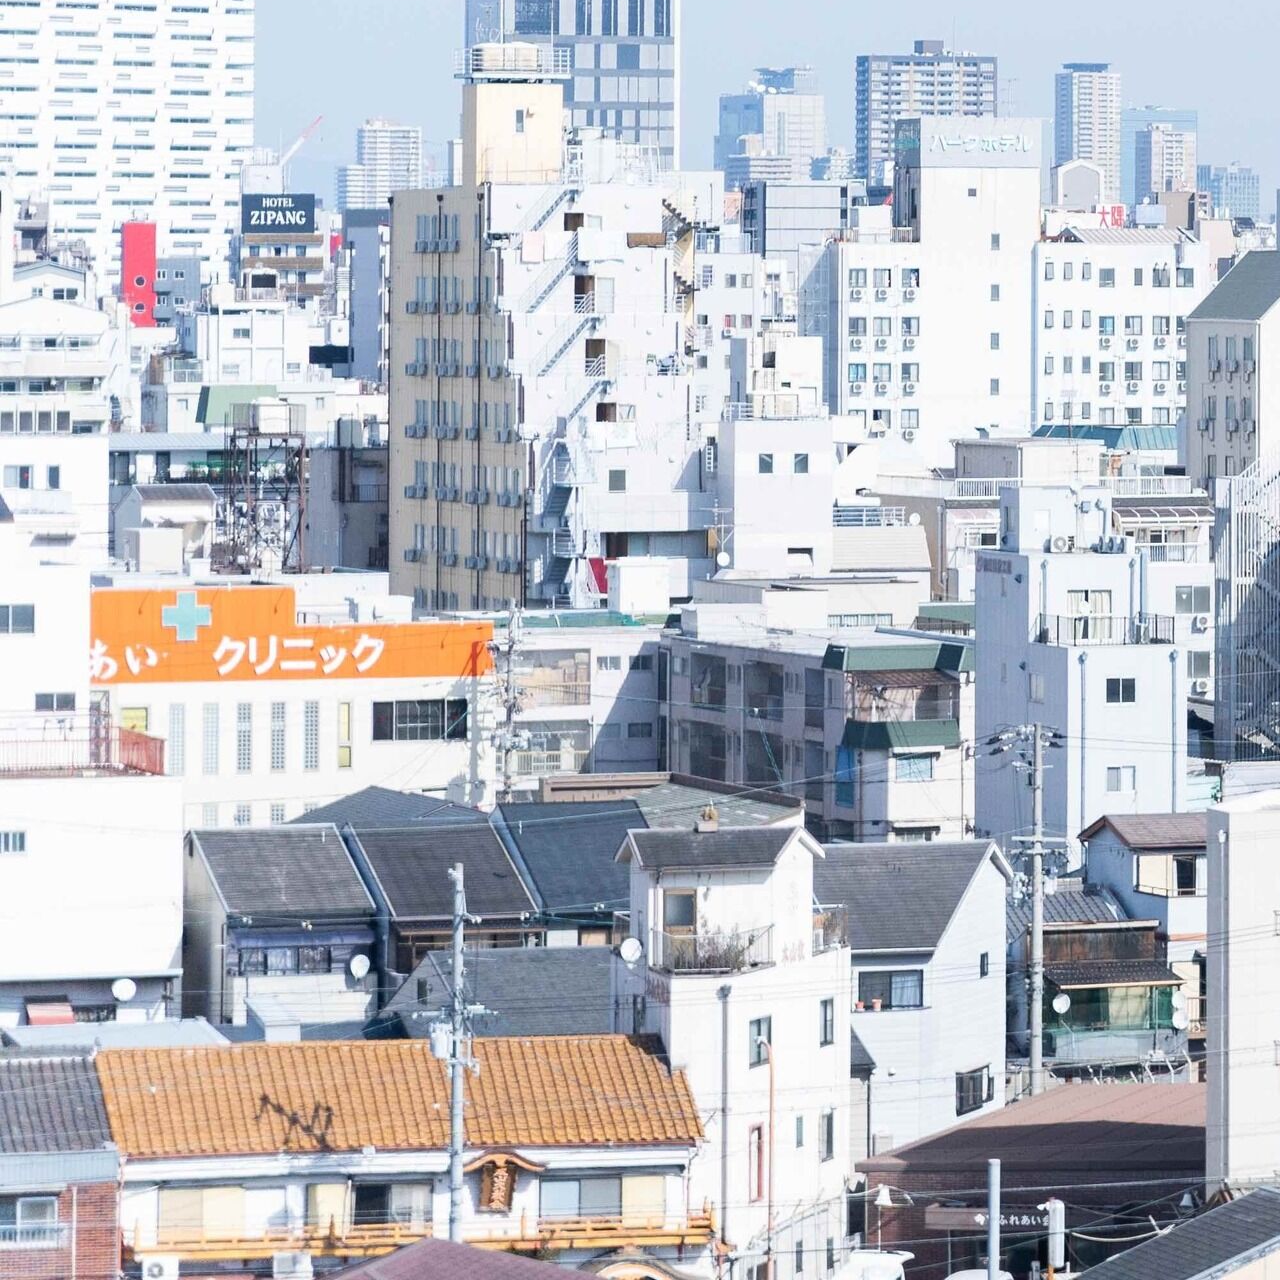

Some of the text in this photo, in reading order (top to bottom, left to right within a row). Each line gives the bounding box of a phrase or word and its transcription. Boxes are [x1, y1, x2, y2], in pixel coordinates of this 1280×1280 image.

[262, 197, 295, 208] HOTEL
[250, 210, 307, 225] ZIPANG
[212, 632, 385, 677] クリニック
